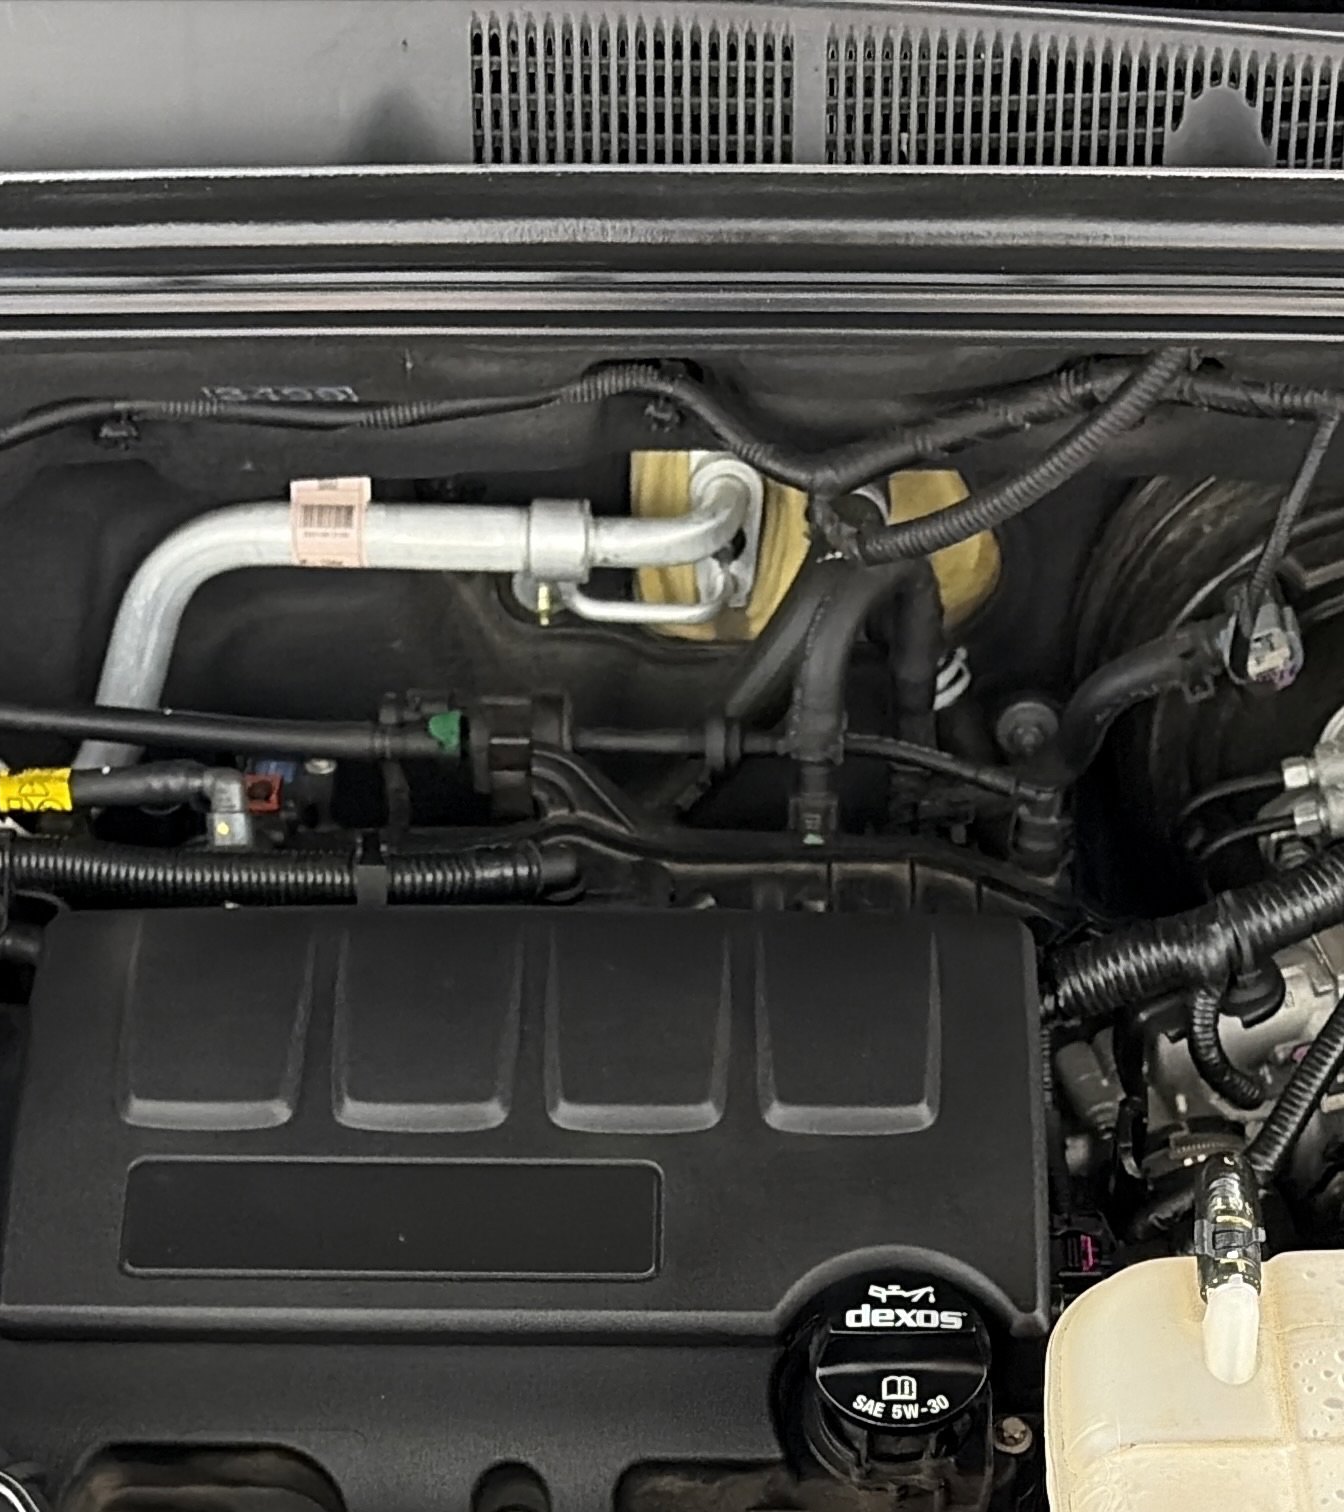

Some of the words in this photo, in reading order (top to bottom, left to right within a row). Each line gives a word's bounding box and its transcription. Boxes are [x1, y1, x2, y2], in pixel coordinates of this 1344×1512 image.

[845, 1304, 963, 1330] dexos
[852, 1394, 886, 1418] SAE
[891, 1394, 950, 1420] 5W-30
